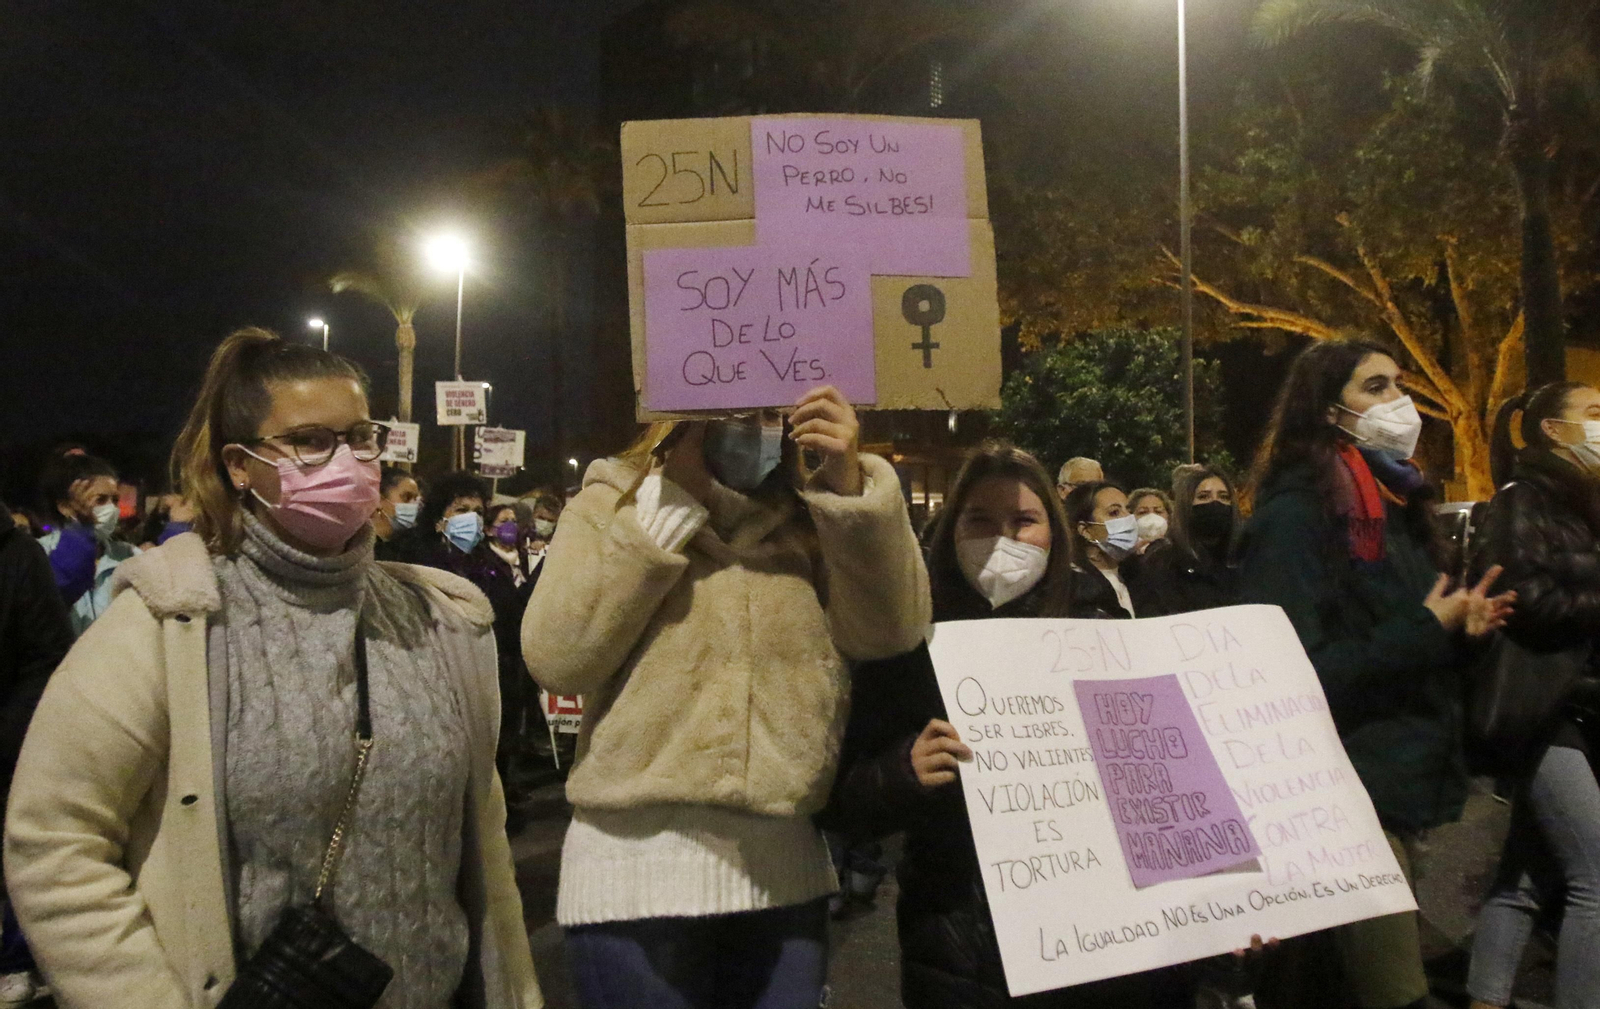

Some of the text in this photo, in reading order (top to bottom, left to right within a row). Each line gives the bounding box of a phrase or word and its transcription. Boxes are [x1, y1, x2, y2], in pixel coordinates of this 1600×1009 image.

[767, 131, 899, 155] NO SOY UN
[635, 149, 738, 208] 25N
[880, 169, 907, 184] NO
[806, 195, 933, 216] ME SILBES!
[676, 258, 846, 311] SOY MÁS
[712, 315, 796, 348] DE LO
[683, 350, 746, 386] QUE
[1169, 623, 1242, 662] DÍA
[956, 677, 1065, 716] QUEREMOS
[1094, 692, 1153, 726] HOY
[968, 721, 1074, 742] SER LIBRES.
[1096, 727, 1188, 760] LUCHO
[975, 747, 1094, 773] NO VALIENTES
[1223, 732, 1315, 769] DE LA
[977, 772, 1100, 815] VIOLACIÓN
[1106, 763, 1173, 795] PARA
[1230, 767, 1346, 809] VIOLENCIA
[1116, 792, 1211, 825] EXISTIR
[1033, 821, 1064, 843] ES
[1127, 819, 1250, 870] MAÑANA
[991, 848, 1102, 893] TORTURA
[1263, 839, 1380, 887] LA MUJER
[1039, 927, 1069, 962] LA
[1073, 921, 1160, 953] IGUALDAD
[1161, 906, 1188, 931] NO
[1190, 904, 1209, 924] ES
[1208, 902, 1246, 921] UNA
[1312, 883, 1335, 899] ES
[1335, 879, 1359, 893] UN
